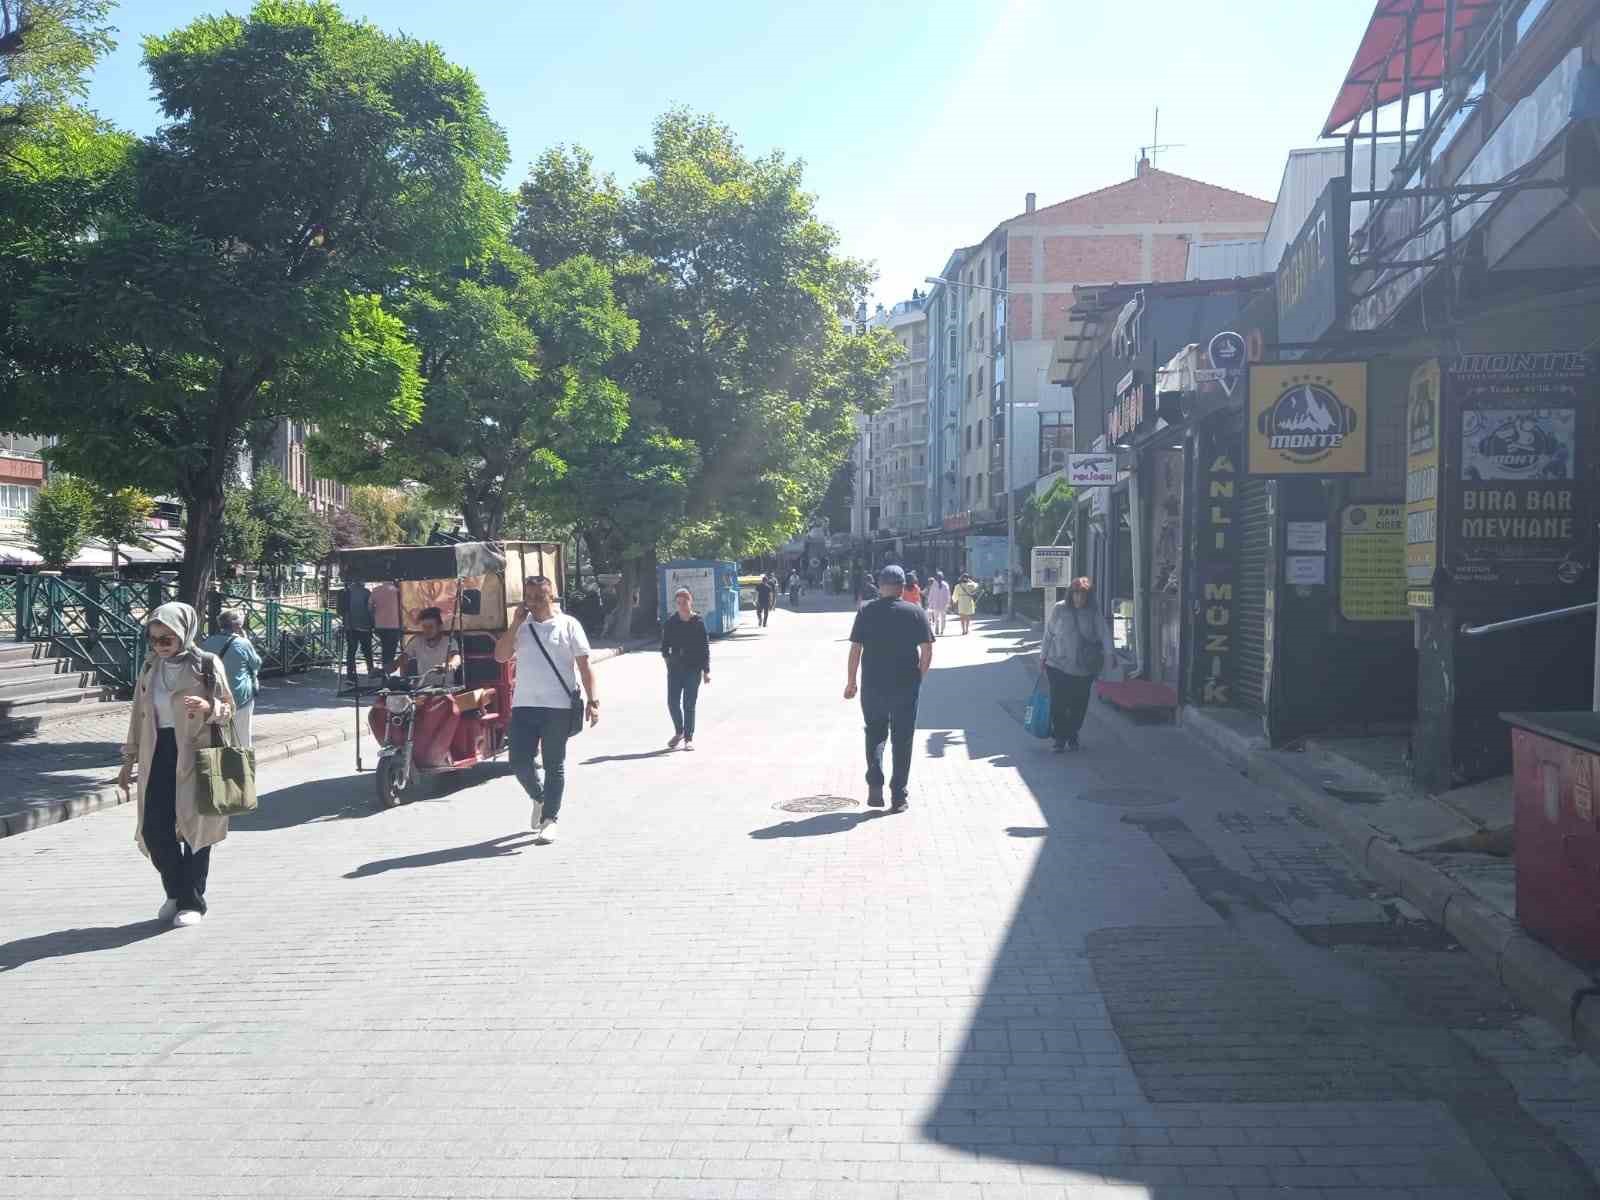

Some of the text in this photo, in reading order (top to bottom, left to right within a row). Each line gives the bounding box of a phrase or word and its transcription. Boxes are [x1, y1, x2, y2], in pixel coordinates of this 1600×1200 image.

[1269, 433, 1345, 449] MONTE
[1527, 490, 1573, 511] BAR
[1461, 517, 1574, 538] MEVHANE
